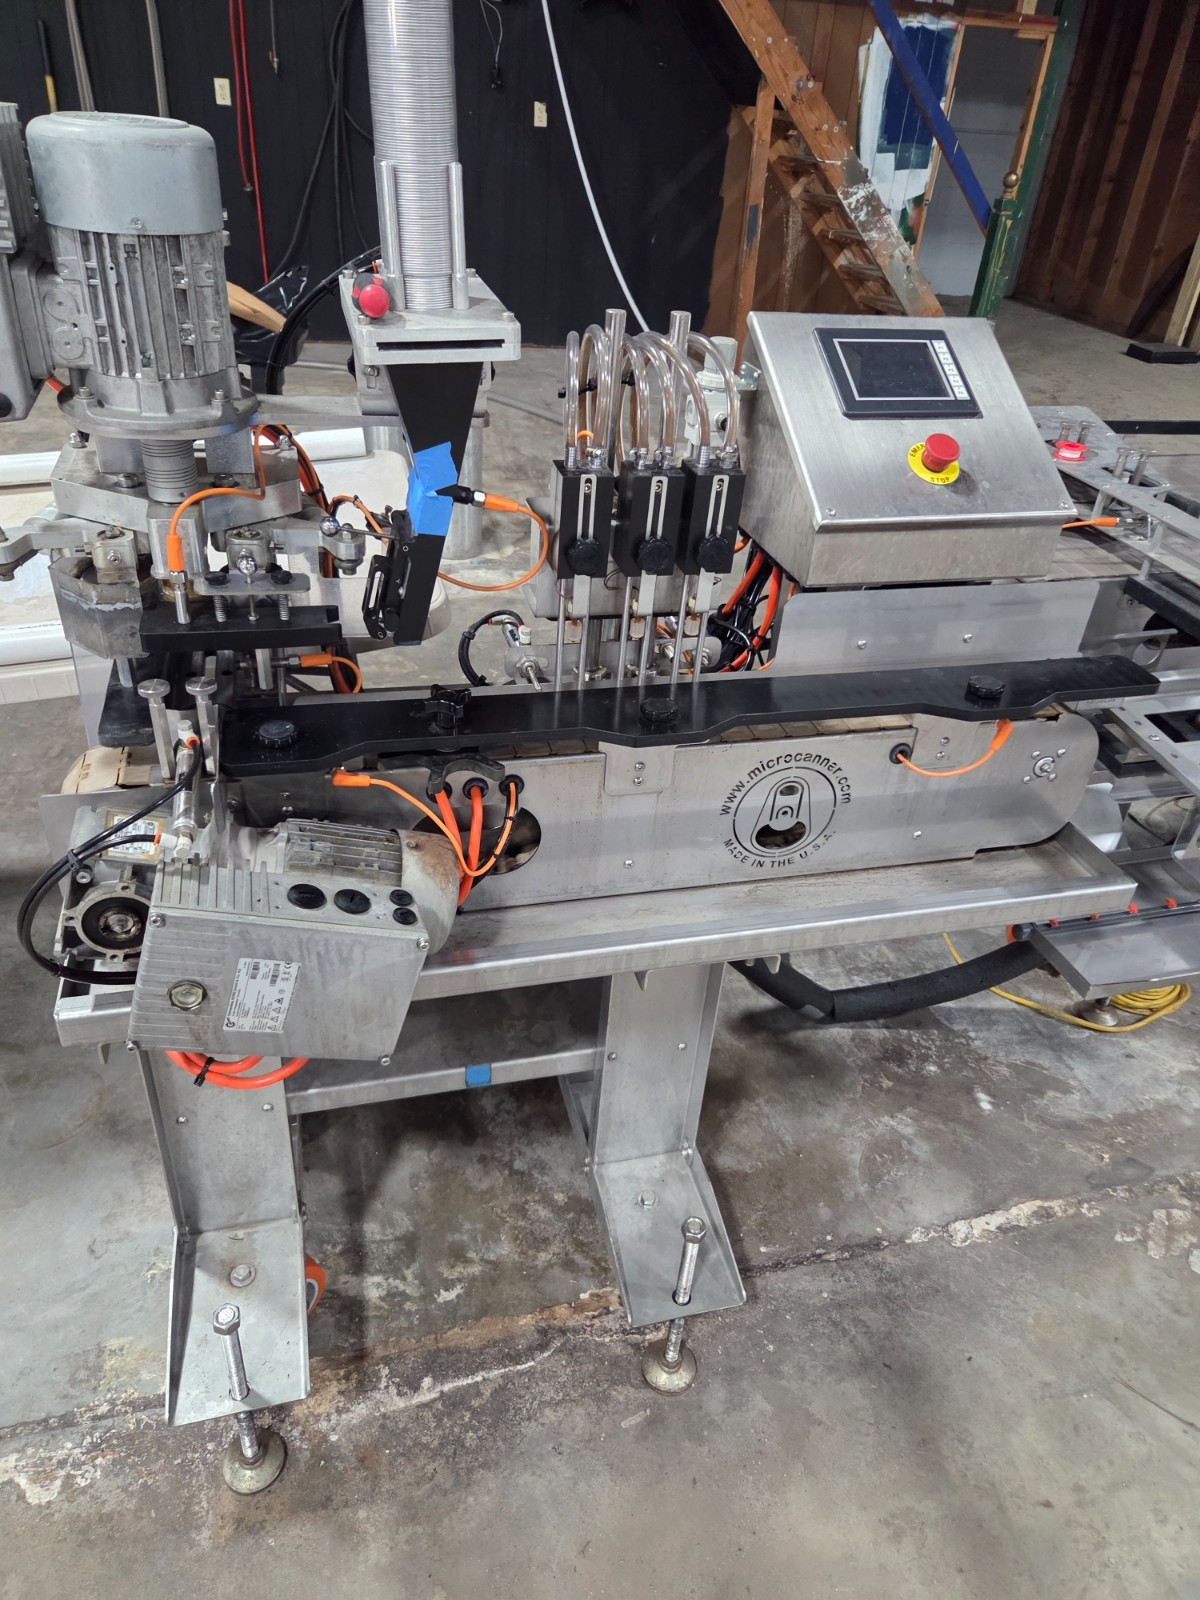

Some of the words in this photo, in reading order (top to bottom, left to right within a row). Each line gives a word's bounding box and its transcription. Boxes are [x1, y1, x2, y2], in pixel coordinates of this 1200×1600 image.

[909, 443, 925, 458] EMER
[930, 476, 950, 484] STOP
[719, 752, 852, 816] www.microcanner.com
[723, 838, 750, 864] MADE
[750, 859, 766, 868] IN
[770, 856, 796, 868] THE
[799, 829, 837, 860] U.S.A.
